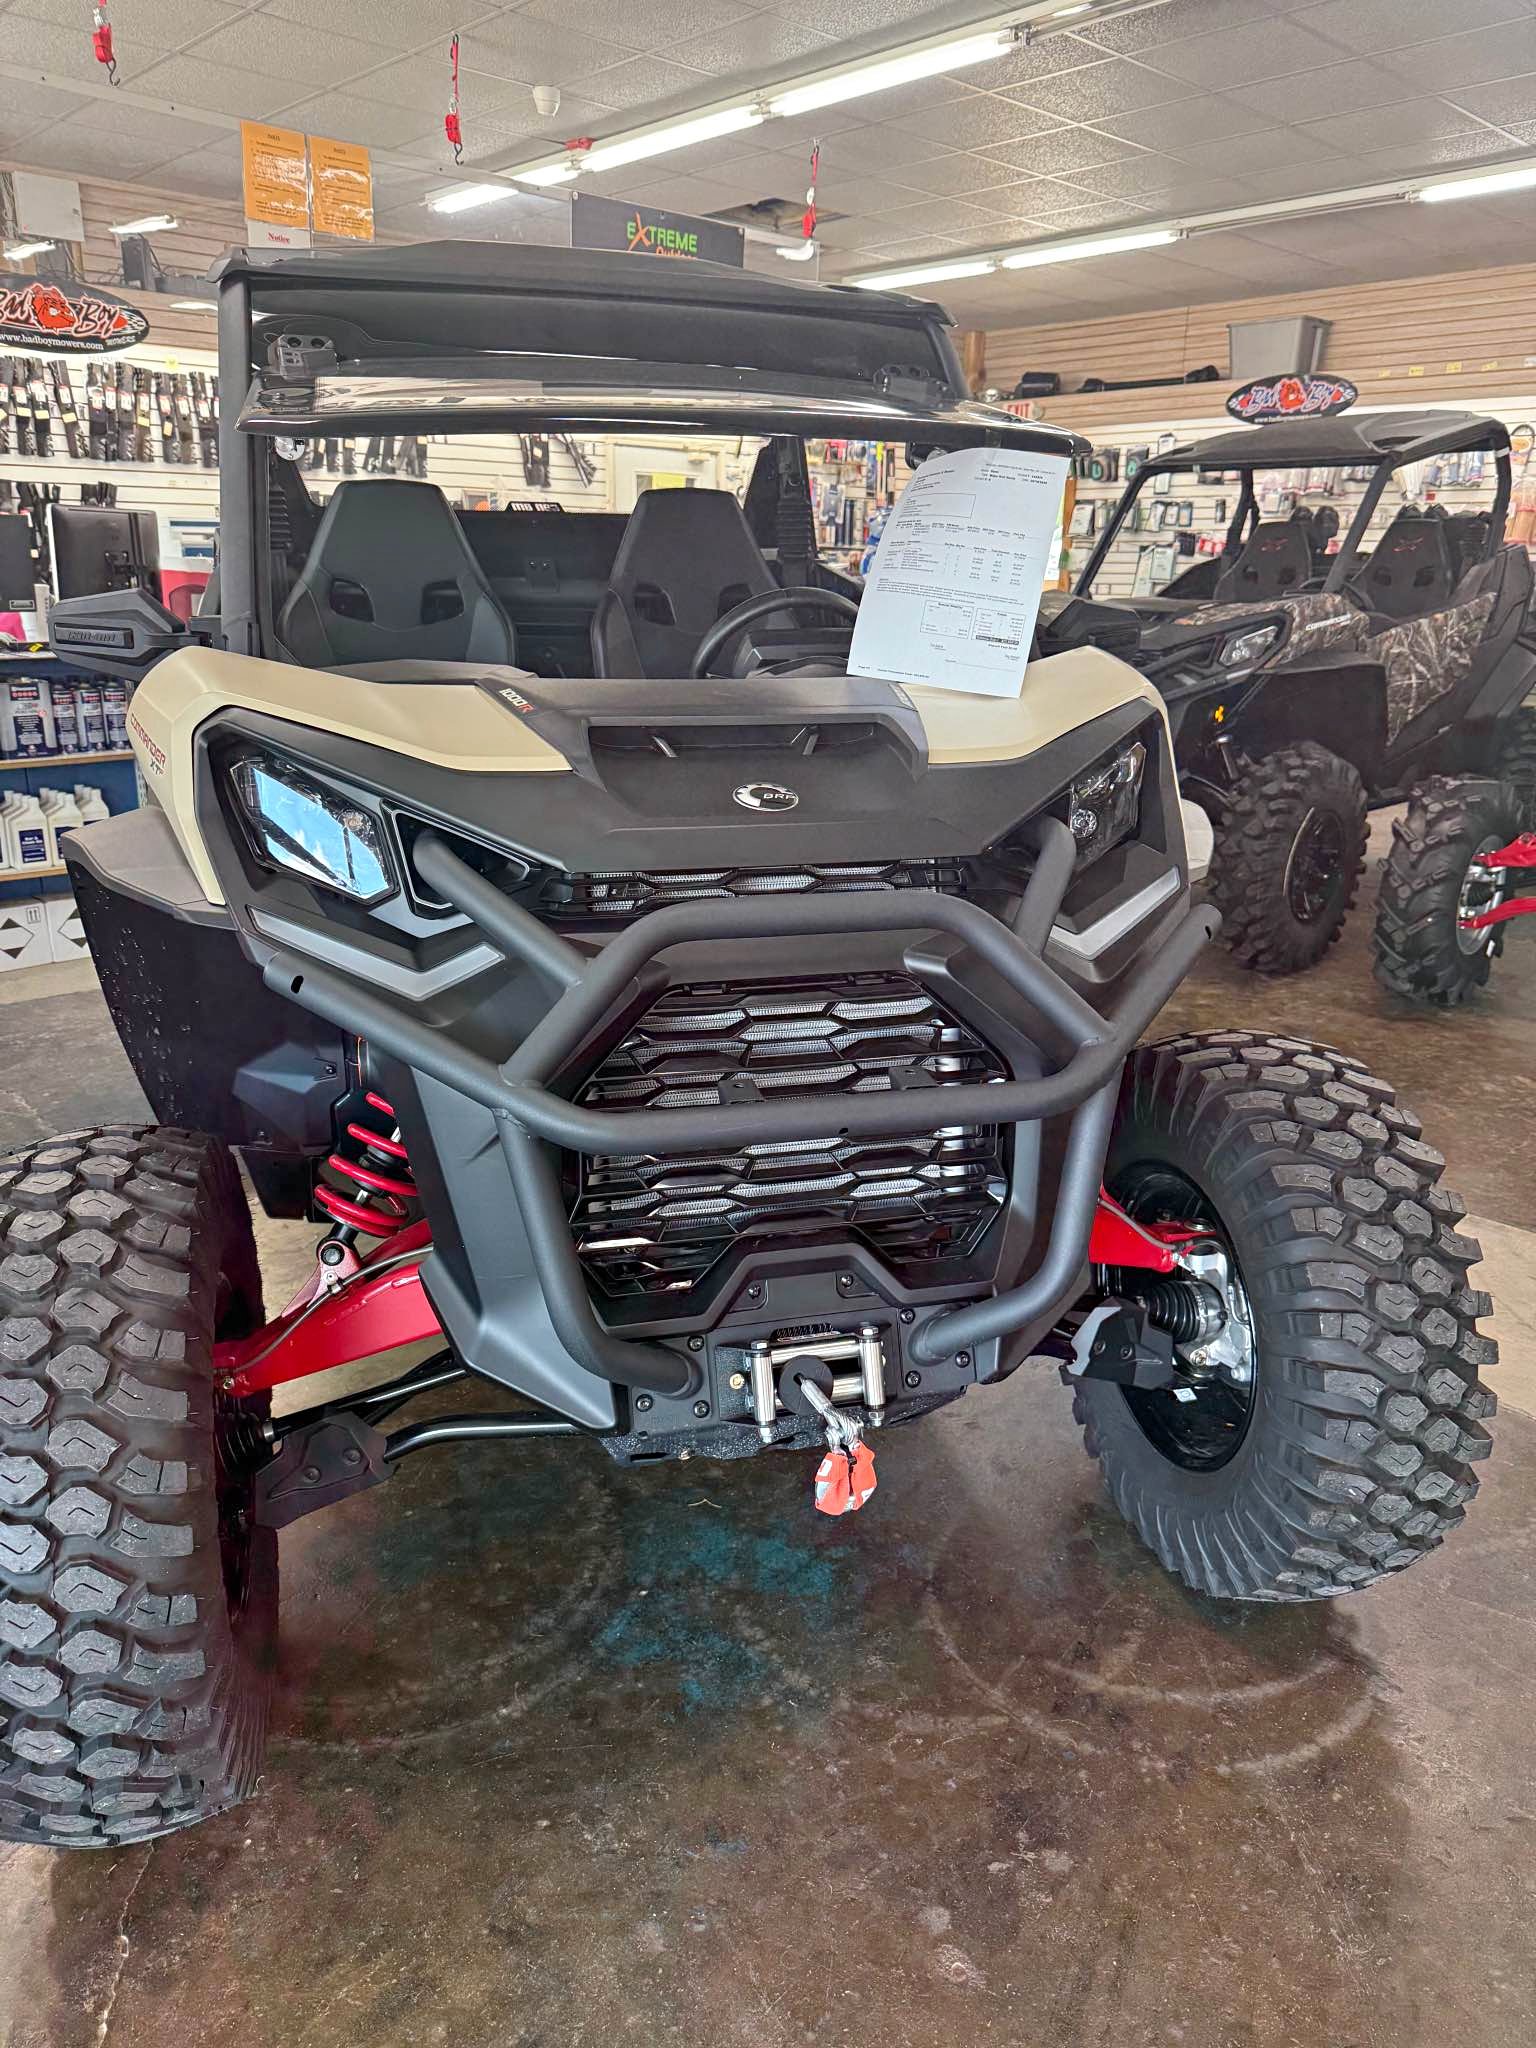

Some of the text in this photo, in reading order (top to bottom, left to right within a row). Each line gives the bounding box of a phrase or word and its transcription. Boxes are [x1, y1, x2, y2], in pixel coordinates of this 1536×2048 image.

[627, 211, 698, 253] EXTREME
[71, 294, 120, 339] Boy
[498, 687, 535, 713] 1000R
